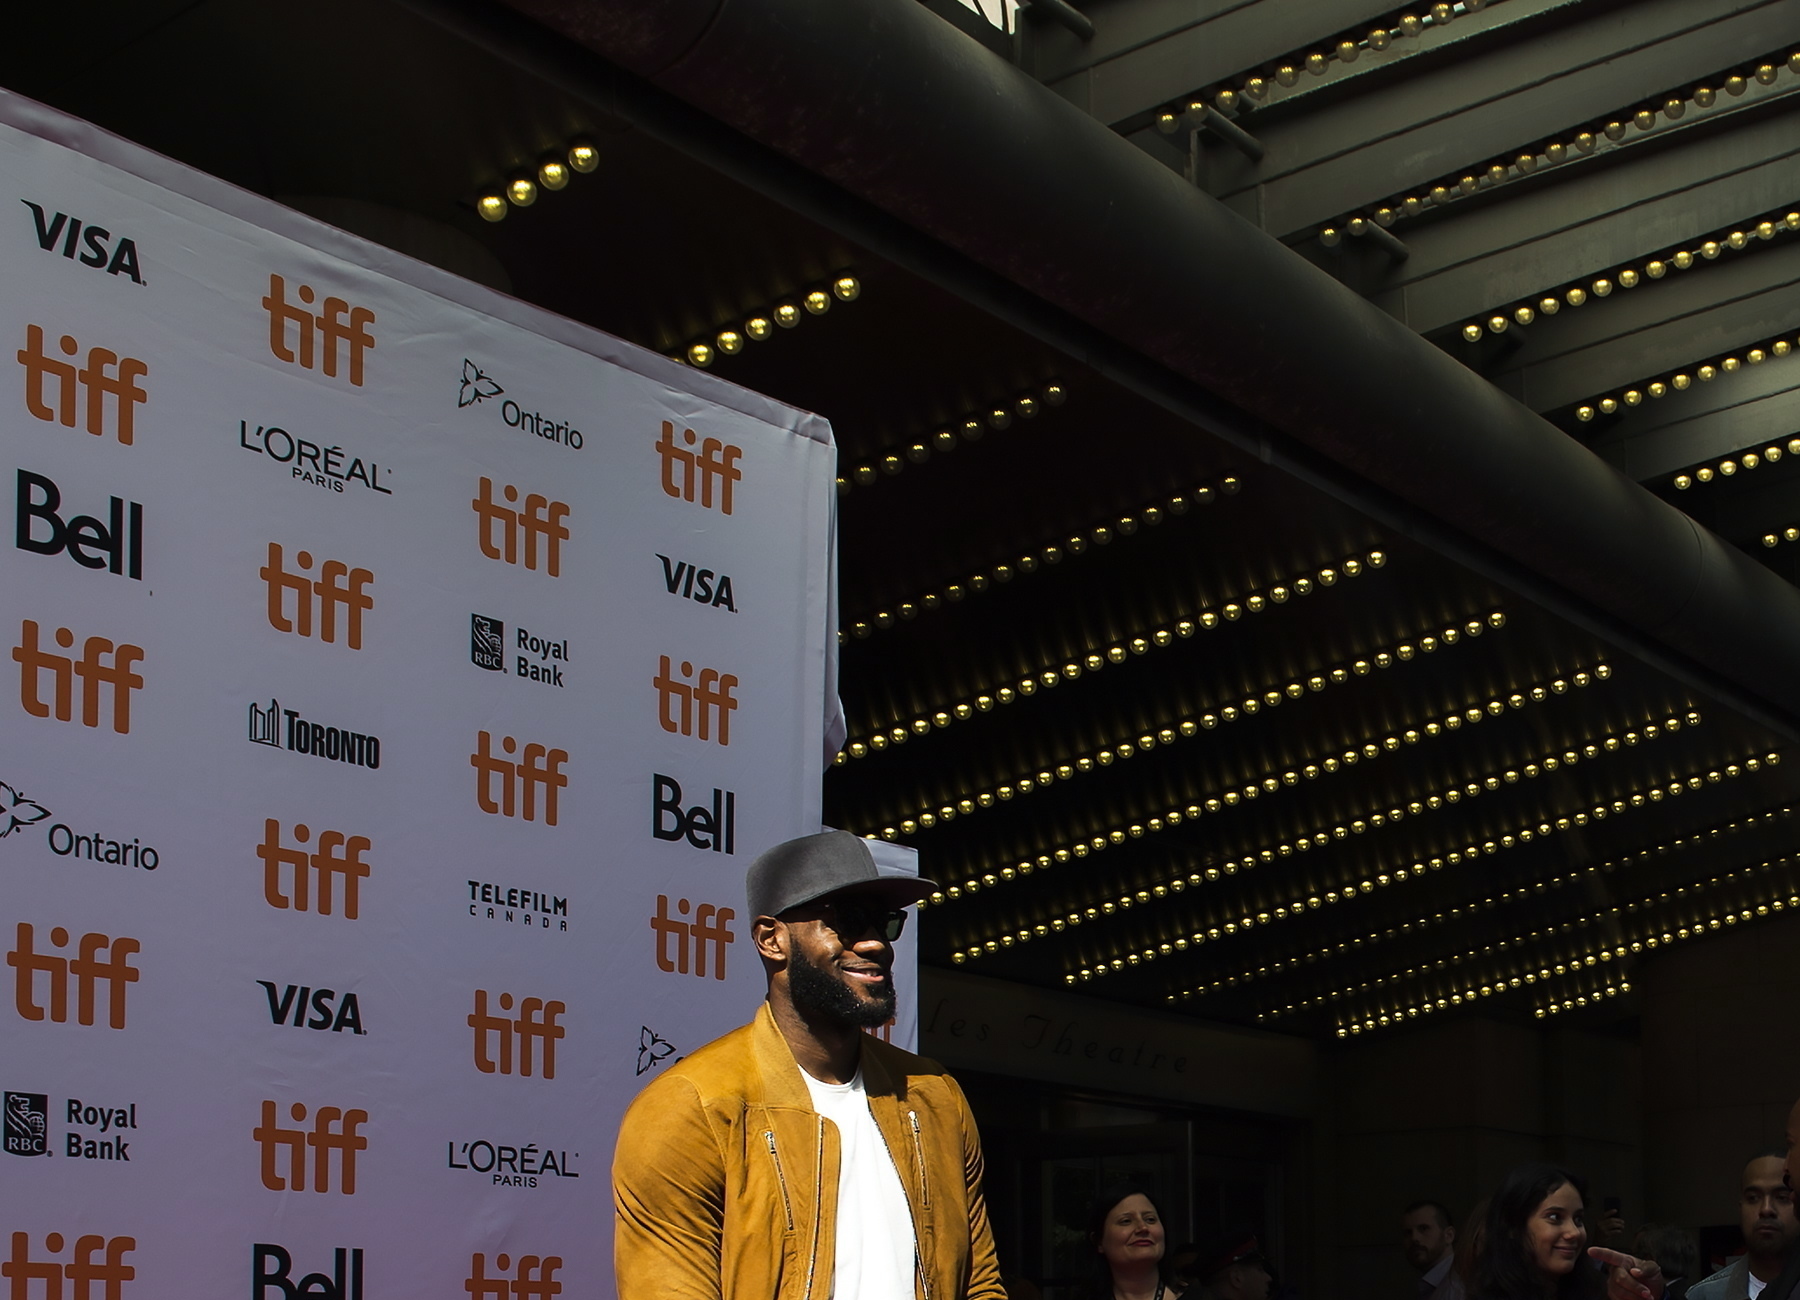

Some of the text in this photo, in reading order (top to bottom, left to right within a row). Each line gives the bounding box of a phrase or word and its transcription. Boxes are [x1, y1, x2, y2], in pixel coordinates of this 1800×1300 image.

[21, 199, 146, 286] VISA
[263, 274, 374, 386] tiff
[18, 325, 147, 445] tiff
[241, 420, 391, 494] L'ORÉAL
[502, 400, 583, 449] Ontario
[292, 467, 344, 492] PARIS
[656, 421, 741, 515] tiff
[16, 469, 142, 580] Bell
[473, 477, 569, 577] tiff
[261, 543, 373, 649] tiff
[656, 554, 734, 612] VISA
[13, 620, 143, 733] tiff
[475, 652, 502, 668] RBC
[518, 628, 568, 661] Royal
[518, 656, 564, 688] Bank
[654, 656, 737, 745] tiff
[284, 709, 379, 769] TORONTO
[471, 731, 568, 825] tiff
[653, 773, 734, 855] Bell
[49, 824, 158, 870] Ontario
[257, 819, 370, 919] tiff
[468, 881, 567, 917] TELEFILM
[470, 904, 567, 932] CANADA
[651, 895, 734, 980] tiff
[7, 923, 139, 1029] tiff
[256, 980, 362, 1034] VISA
[468, 990, 565, 1079] tiff
[925, 999, 990, 1041] les
[1021, 1013, 1188, 1073] Theatre
[8, 1137, 43, 1152] RBC
[67, 1099, 137, 1133] Royal
[67, 1132, 130, 1161] Bank
[254, 1101, 367, 1194] tiff
[449, 1140, 579, 1178] L'ORÉAL
[493, 1174, 538, 1188] PARIS
